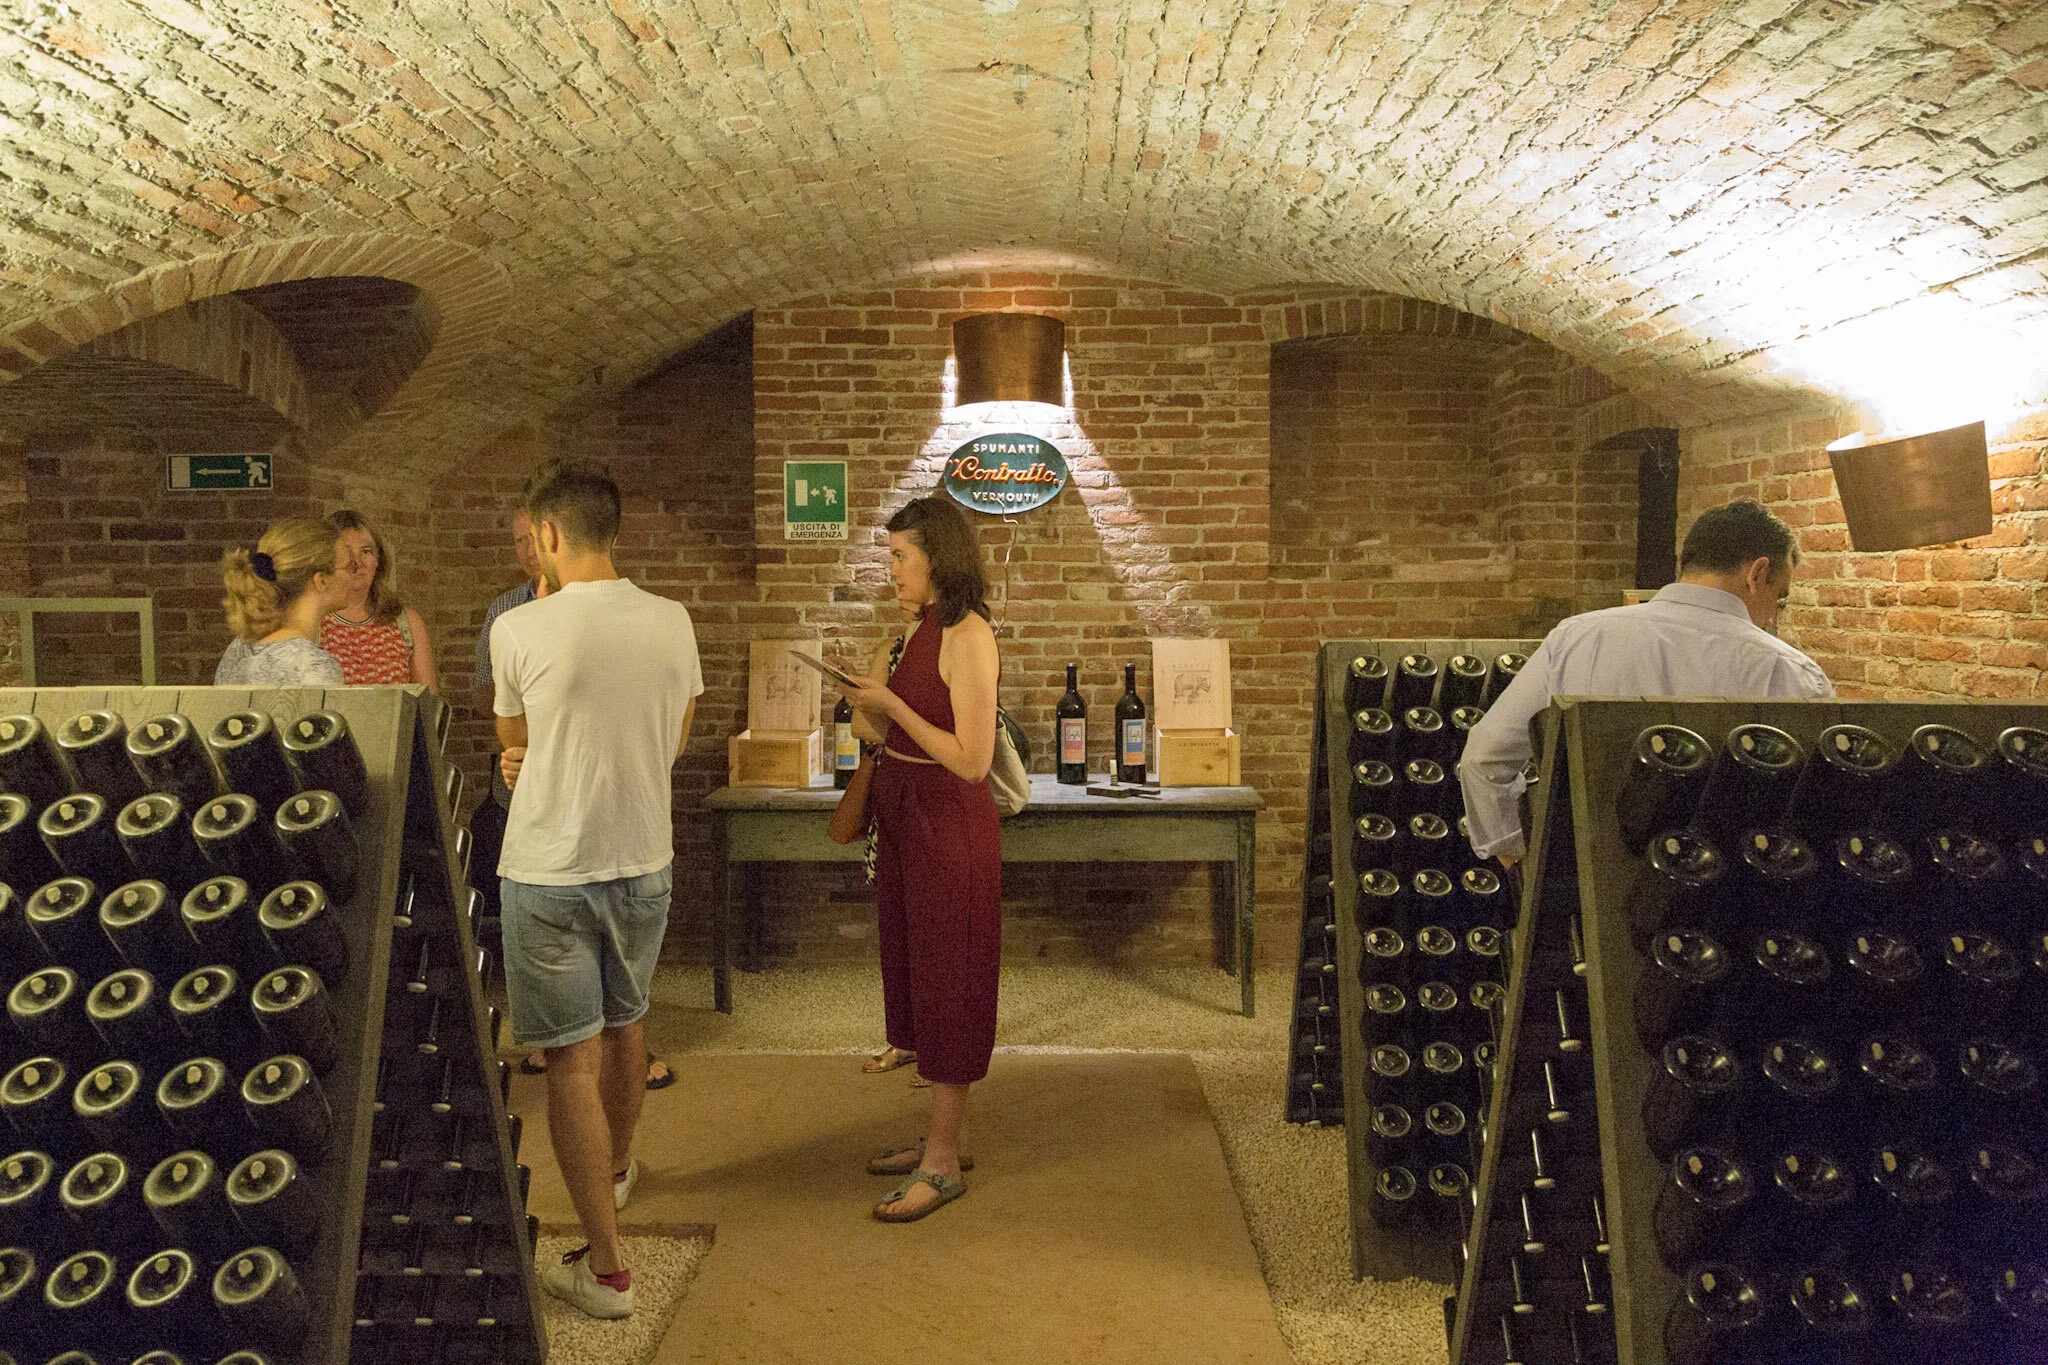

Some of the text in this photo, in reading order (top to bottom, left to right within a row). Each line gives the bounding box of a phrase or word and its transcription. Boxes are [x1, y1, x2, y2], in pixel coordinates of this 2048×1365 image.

[972, 443, 1040, 455] SPUMANTI
[972, 491, 1040, 504] VERMOUTH
[793, 523, 840, 531] USCITA DI
[790, 531, 843, 539] EMERGENZA
